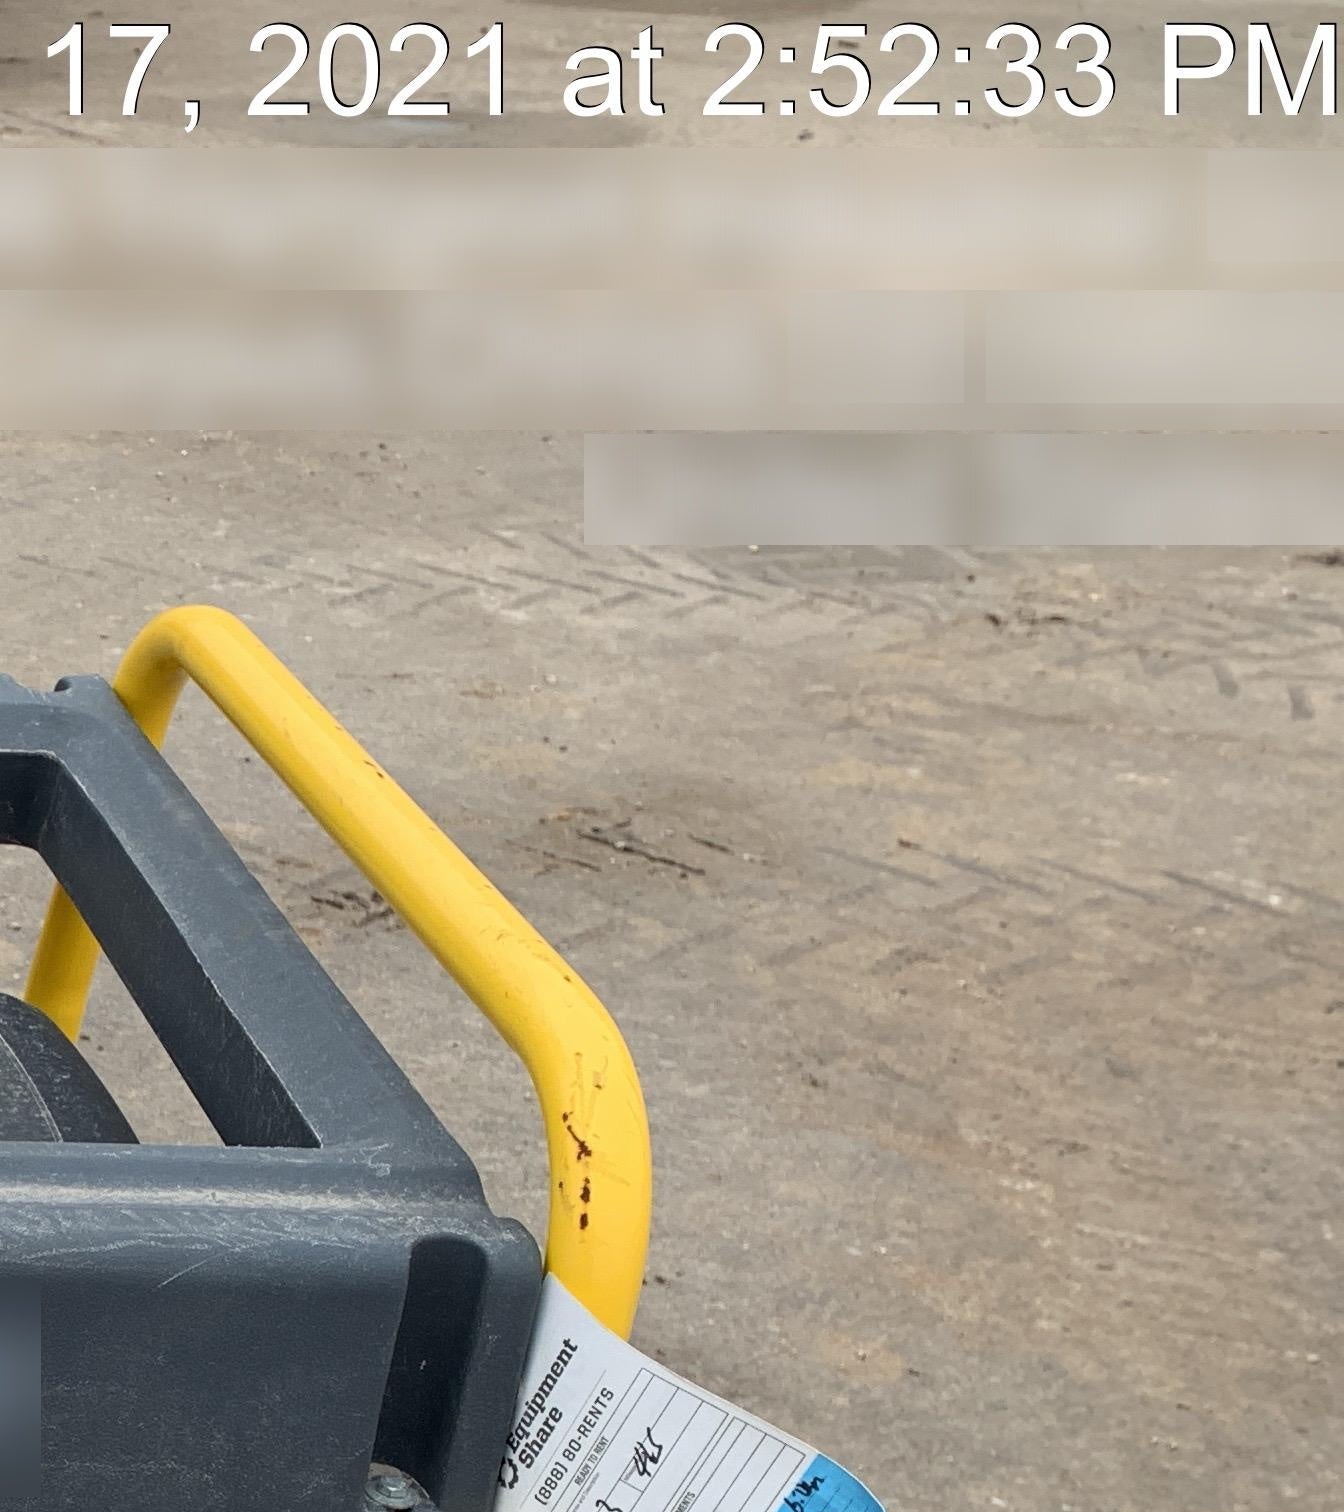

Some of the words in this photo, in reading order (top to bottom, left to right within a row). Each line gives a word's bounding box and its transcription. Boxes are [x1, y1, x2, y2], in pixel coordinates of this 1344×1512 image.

[506, 1336, 578, 1454] Equipment
[518, 1407, 563, 1469] Share
[535, 1461, 568, 1505] (888)
[563, 1387, 614, 1462] 80-RENTS
[574, 1460, 592, 1486] READY
[587, 1455, 599, 1465] TO
[593, 1436, 609, 1459] RENT
